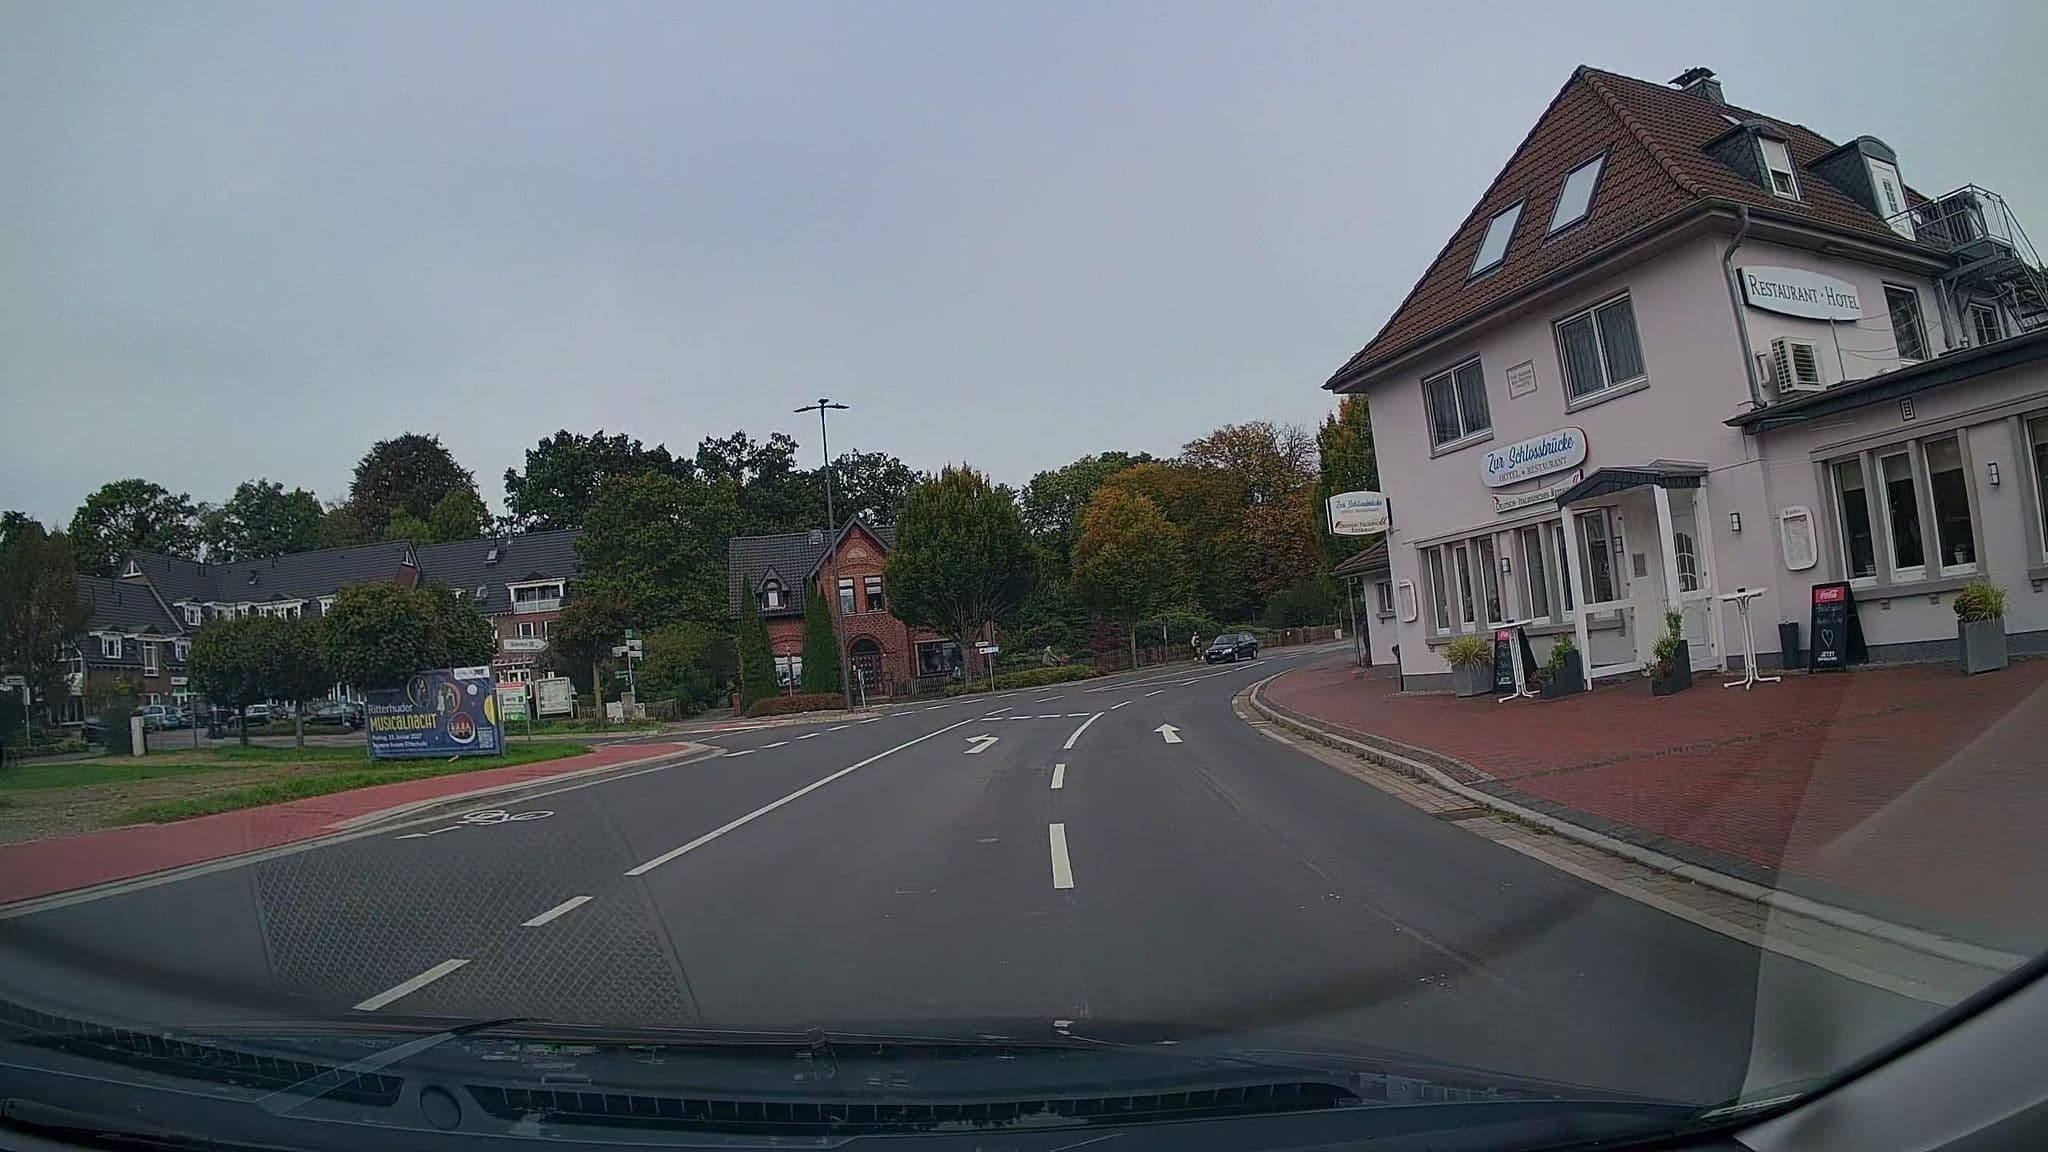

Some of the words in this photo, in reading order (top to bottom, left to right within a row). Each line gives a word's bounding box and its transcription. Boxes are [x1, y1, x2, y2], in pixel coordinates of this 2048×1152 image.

[1748, 274, 1818, 303] RESTAURANT
[1824, 286, 1860, 309] HOTEL
[1487, 453, 1504, 474] Zur
[1508, 432, 1573, 469] Schlossbrücke
[1499, 470, 1519, 482] HOTEL
[1526, 456, 1567, 474] RESTAURANT
[368, 702, 413, 714] Ritterhuder
